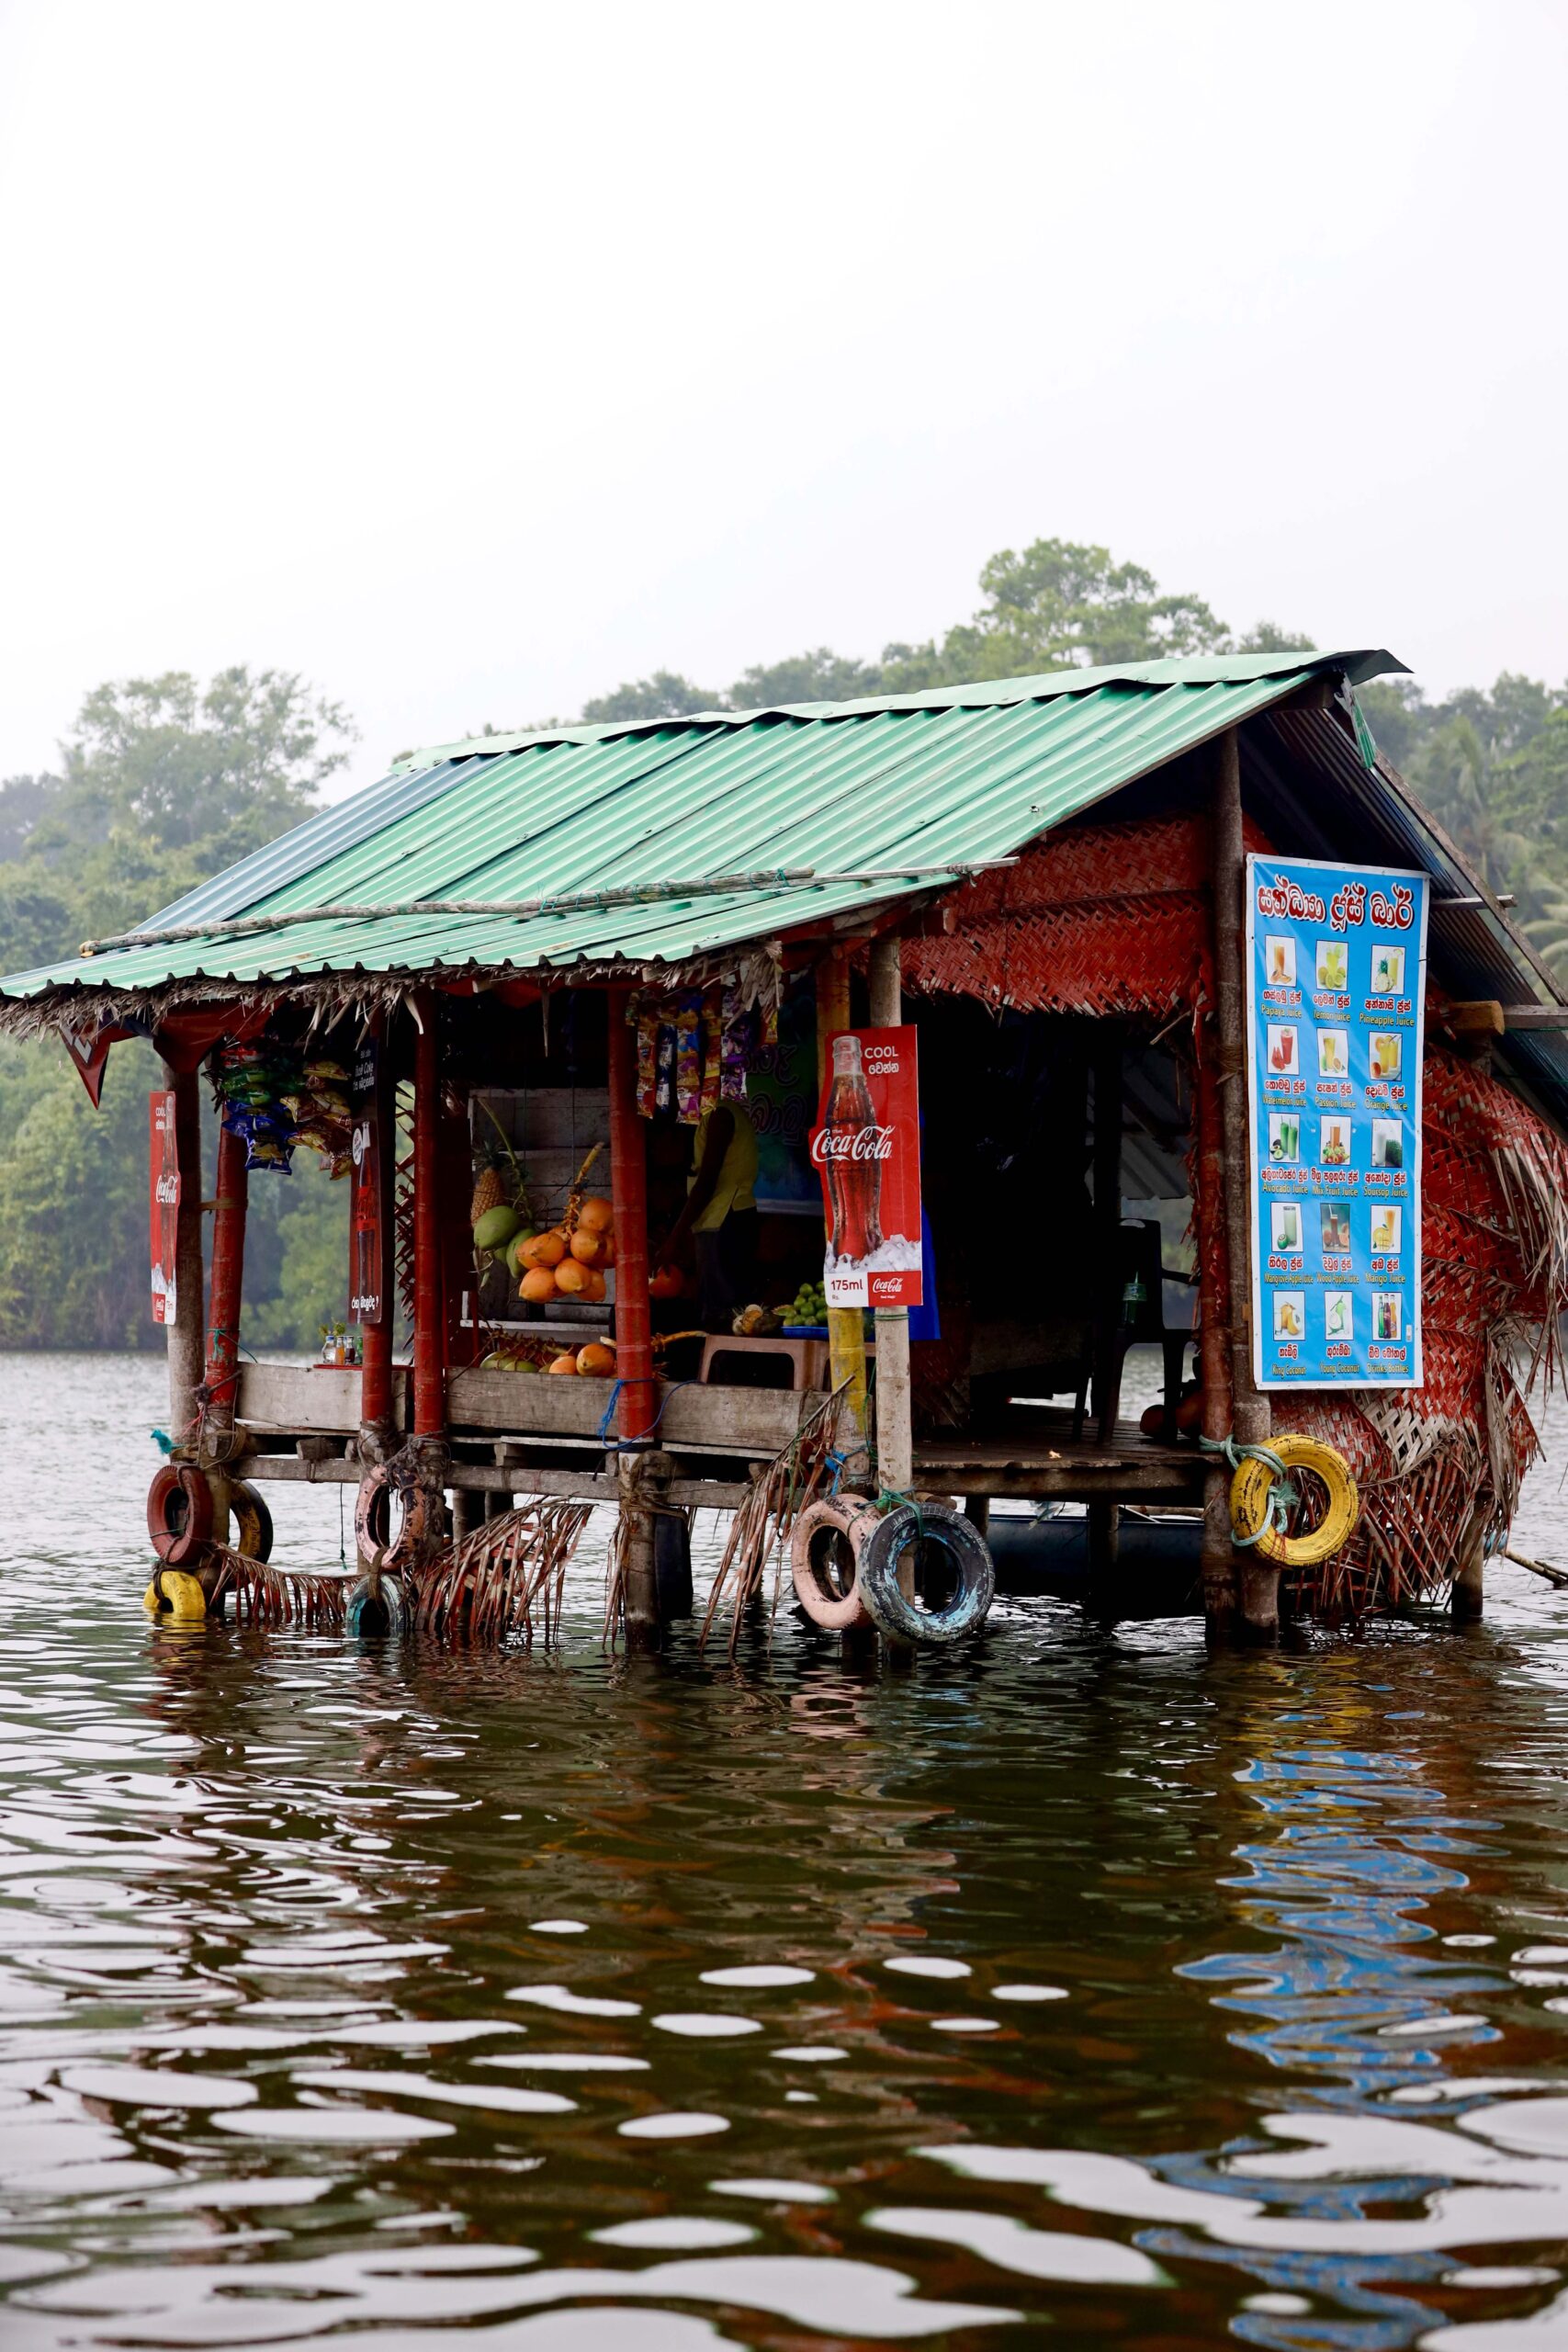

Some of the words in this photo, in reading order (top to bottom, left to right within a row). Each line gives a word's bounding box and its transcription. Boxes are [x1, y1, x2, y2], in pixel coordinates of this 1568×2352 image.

[1371, 883, 1413, 929] බාර්
[1261, 1003, 1284, 1019] Papaya
[1359, 1012, 1394, 1026] Pineapple
[1396, 1015, 1415, 1026] Juice
[864, 1046, 898, 1058] COOL
[869, 1061, 898, 1074] වෙන්න
[1315, 1096, 1337, 1107] Passion
[1365, 1099, 1390, 1113] Orange
[812, 1125, 896, 1162] Coca-Cola
[1262, 1183, 1290, 1193] Avocado
[1292, 1183, 1308, 1193] Juice
[1325, 1185, 1340, 1196] Fruit
[1342, 1187, 1358, 1197] Juice
[1364, 1187, 1389, 1199] Soursop
[1392, 1187, 1408, 1198] Juice
[830, 1279, 863, 1291] 175ml
[873, 1278, 903, 1293] Coca-Cola
[1365, 1273, 1387, 1285] Mango
[1389, 1273, 1405, 1283] Juice
[1272, 1363, 1285, 1378] King
[1286, 1364, 1306, 1375] Coconut
[1320, 1362, 1336, 1377] Young
[1337, 1363, 1359, 1374] Coconut
[1367, 1363, 1387, 1374] Drinks
[1388, 1363, 1408, 1374] Bottles
